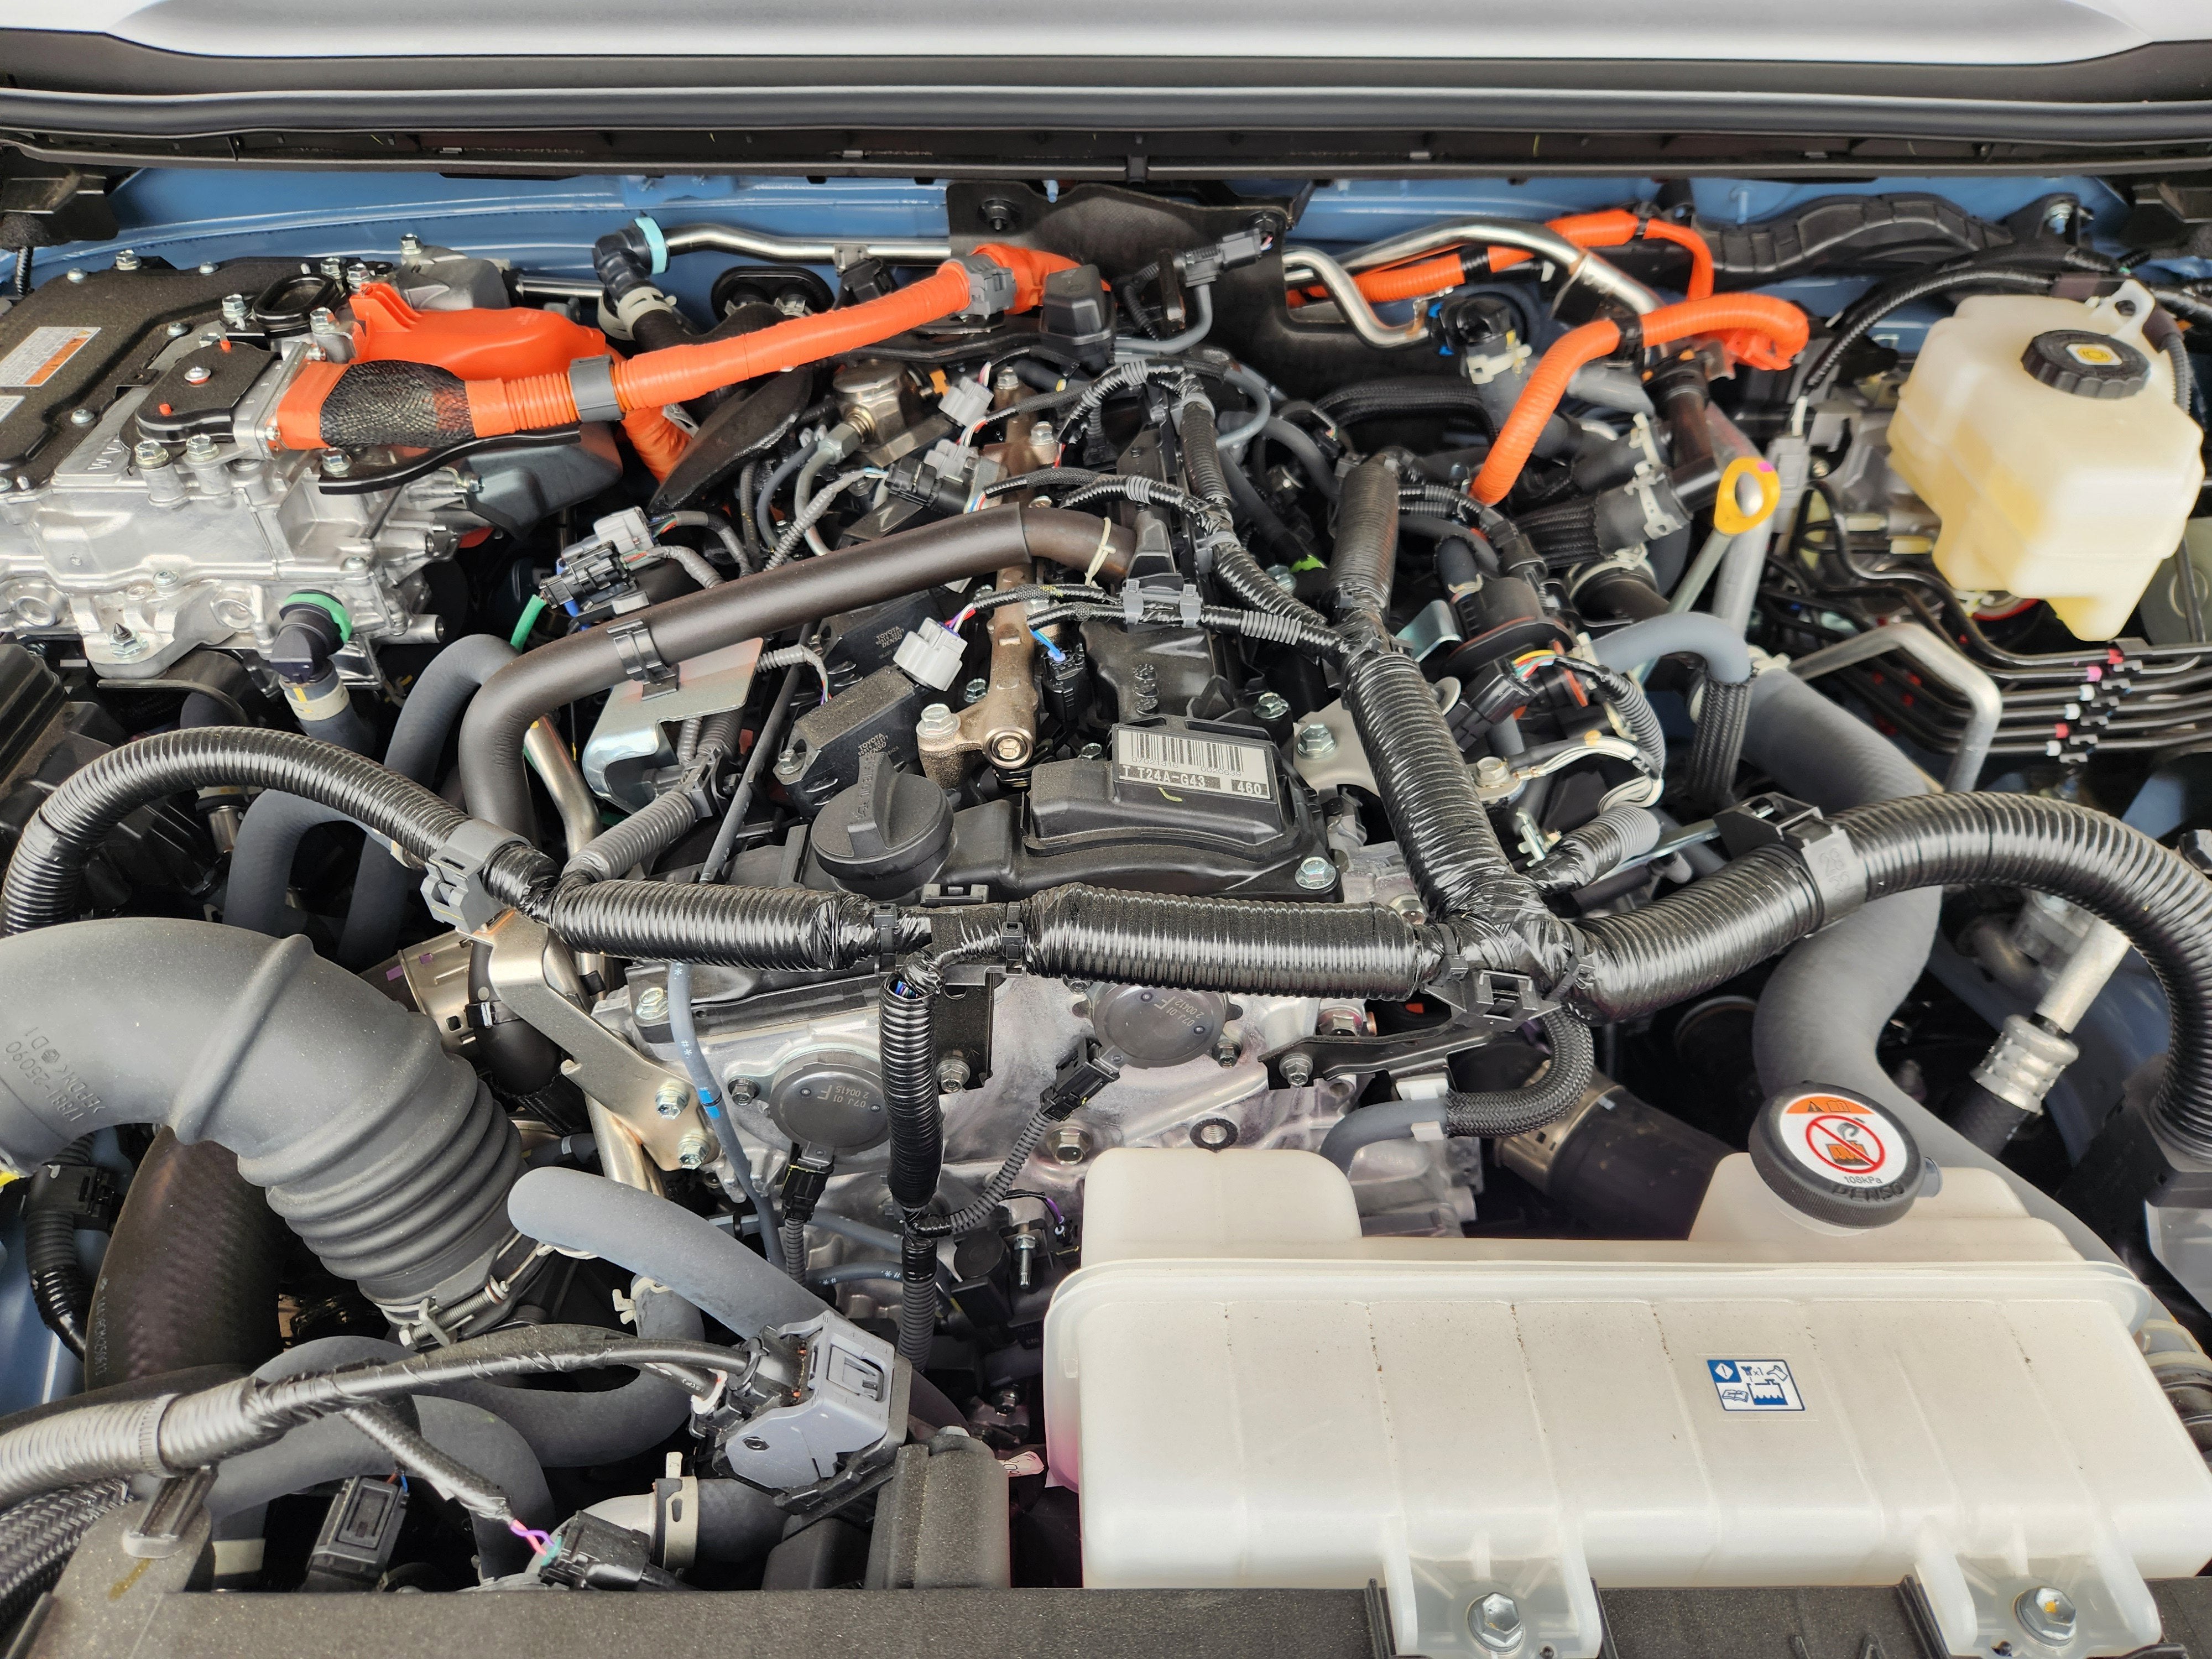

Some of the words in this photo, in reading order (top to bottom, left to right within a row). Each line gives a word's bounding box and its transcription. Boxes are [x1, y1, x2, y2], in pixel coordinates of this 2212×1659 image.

[875, 626, 901, 640] TOYOTA
[882, 634, 902, 649] DENSO
[858, 733, 885, 750] TOYOTA
[865, 742, 887, 755] DENSO
[1131, 757, 1179, 768] 07021316
[1201, 766, 1241, 777] 0020639
[1123, 765, 1131, 777] T
[1138, 766, 1206, 787] T24A-G43
[1237, 781, 1262, 795] 460
[1154, 996, 1176, 1010] F
[817, 1084, 832, 1100] F
[1831, 1182, 1905, 1202] DENSO
